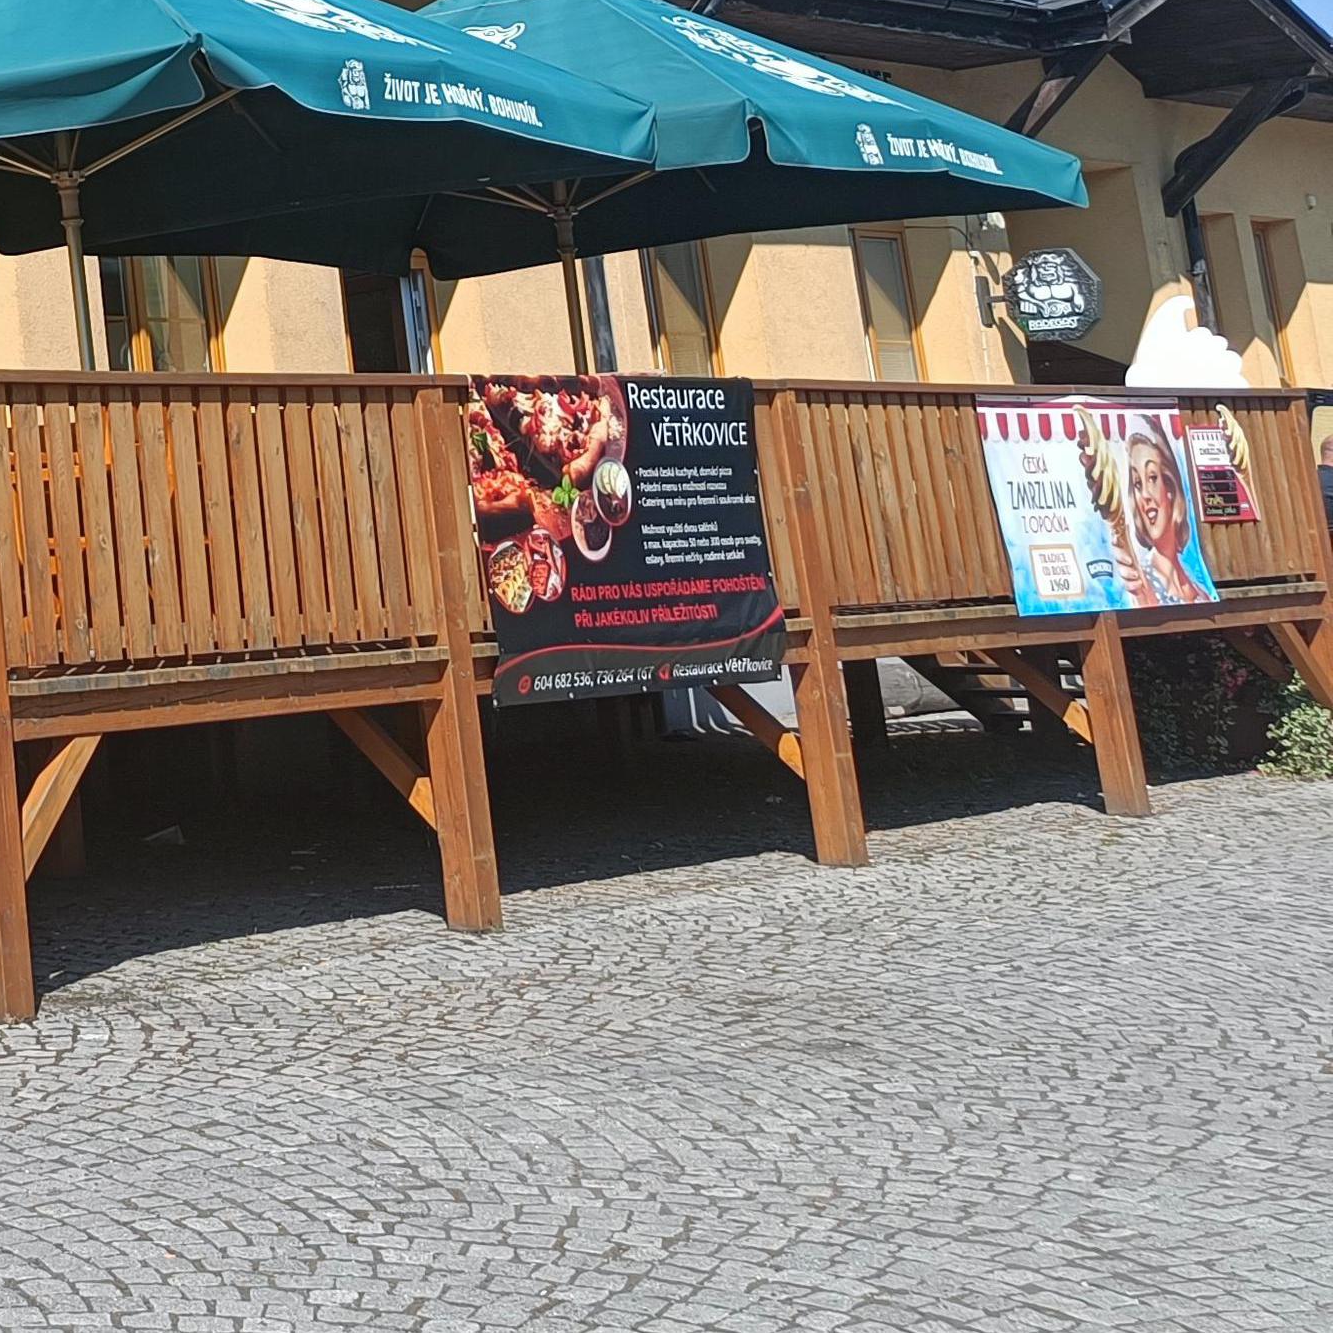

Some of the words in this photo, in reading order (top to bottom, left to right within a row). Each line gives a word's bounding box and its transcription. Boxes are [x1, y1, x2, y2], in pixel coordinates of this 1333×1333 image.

[384, 72, 420, 103] ŽIVOT
[424, 82, 441, 105] JE
[441, 82, 489, 113] HOŘKÝ.
[916, 139, 930, 158] JE
[1028, 316, 1080, 331] RADEGAST
[627, 382, 726, 409] Restaurace
[651, 416, 748, 447] VĚTŘKOVICE
[1022, 453, 1048, 474] ČESKÁ
[1007, 481, 1076, 510] ZMRZLINA
[1029, 513, 1070, 533] OPOČNA
[571, 583, 597, 602] RÁDI
[598, 584, 620, 600] PRO
[621, 580, 643, 599] VÁS
[644, 577, 712, 597] USPOŘÁDÁME
[1049, 577, 1070, 592] 1960
[575, 609, 593, 628] PŘI
[594, 607, 650, 626] JAKÉKOLIV
[533, 675, 553, 691] 604
[554, 673, 572, 689] 682
[672, 660, 723, 677] Restaurace
[724, 657, 773, 673] Větřkovice
